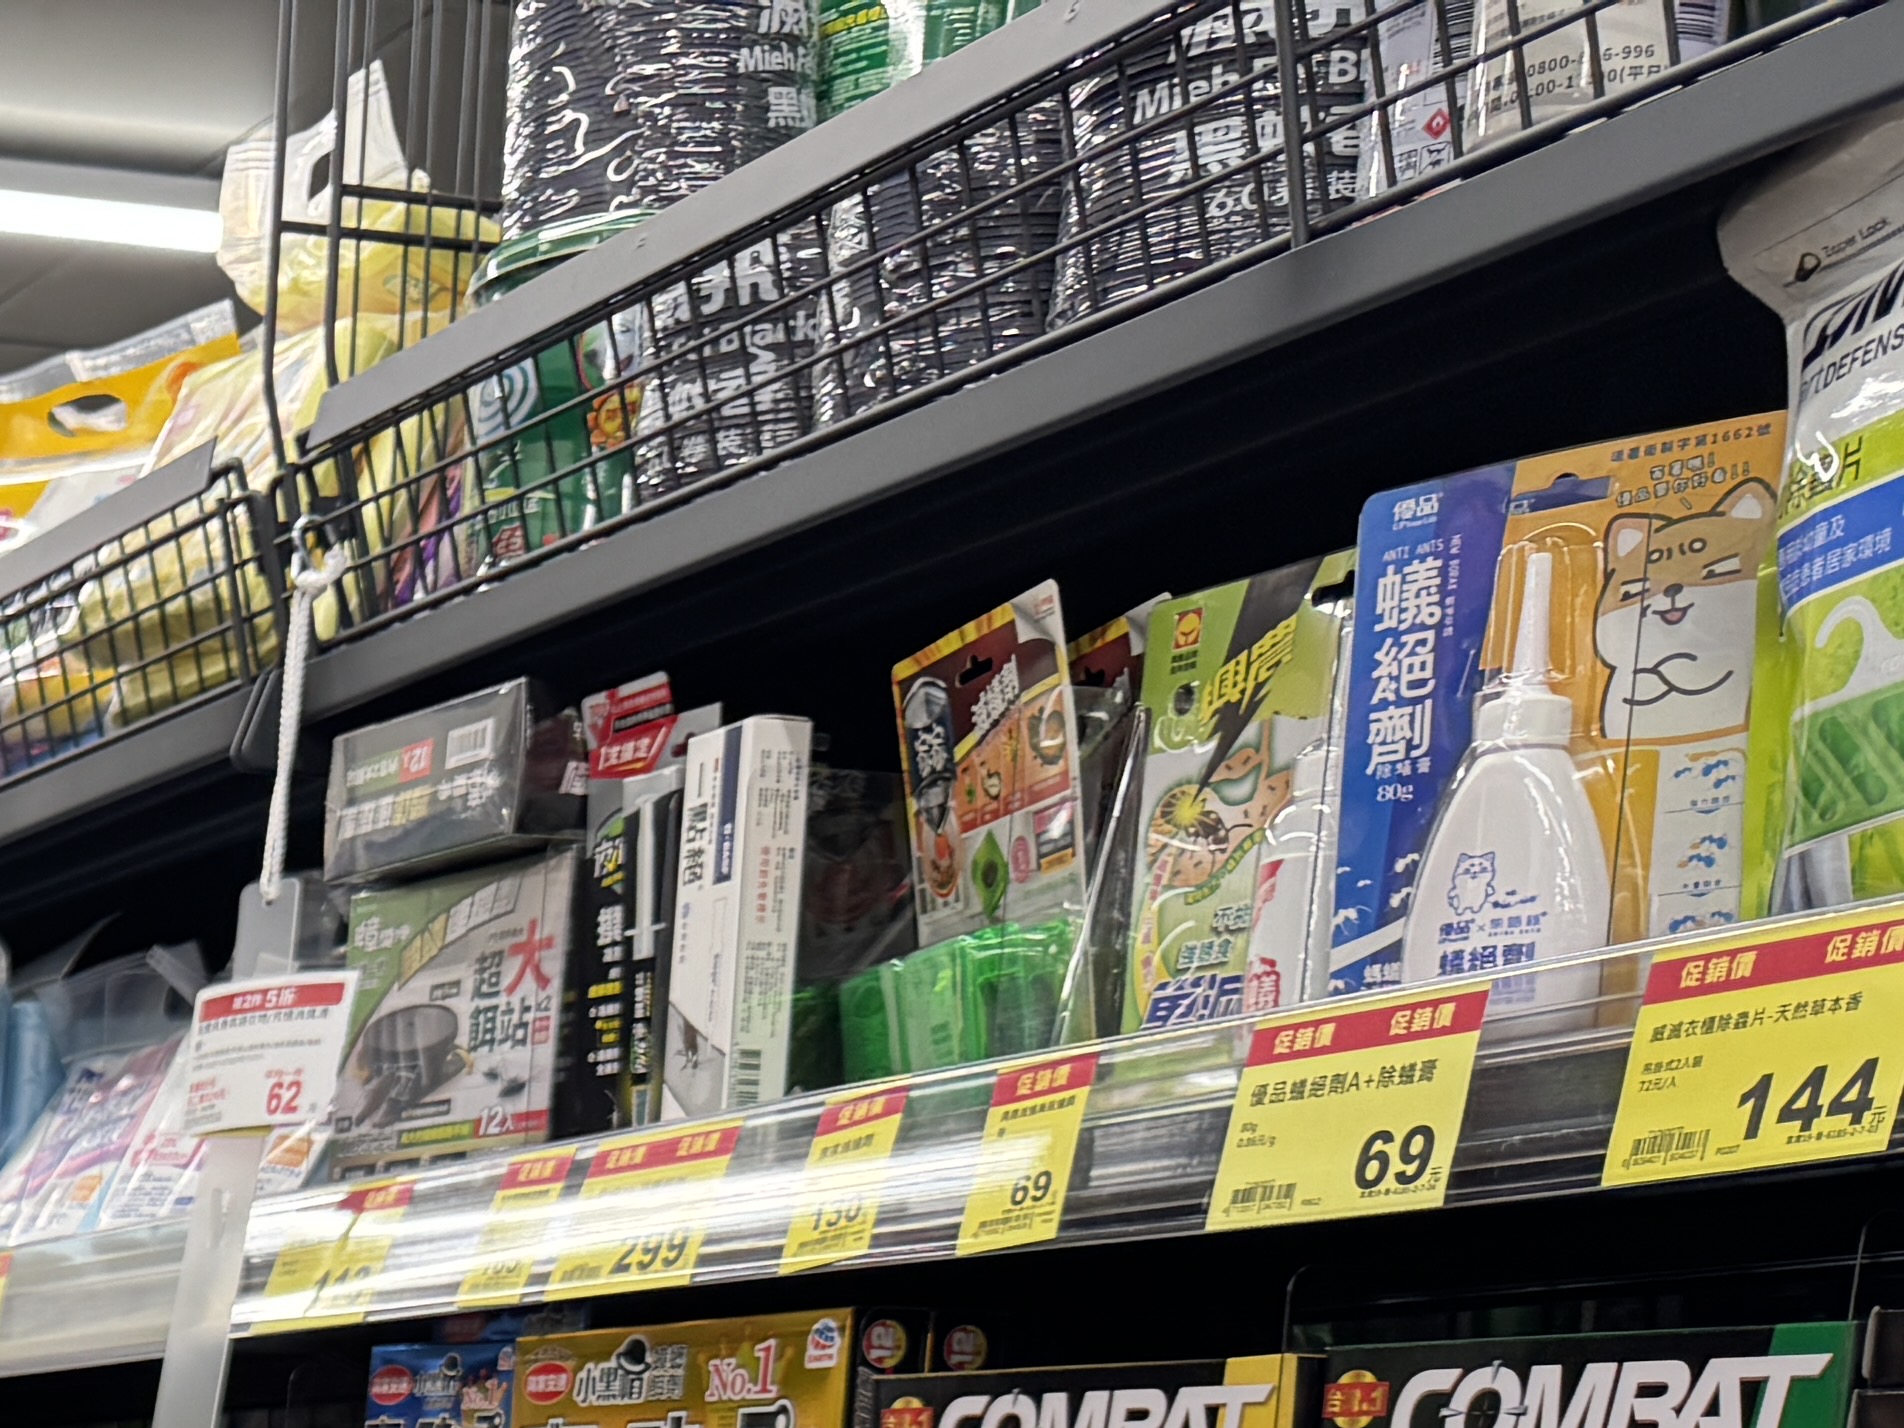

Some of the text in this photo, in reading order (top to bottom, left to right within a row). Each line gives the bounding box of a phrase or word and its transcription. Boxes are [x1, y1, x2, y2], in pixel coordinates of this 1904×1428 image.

[1366, 557, 1442, 776] 蟻絕劑
[1376, 782, 1414, 803] 80g
[266, 1079, 303, 1116] 62
[1737, 1056, 1880, 1141] 144
[1354, 1124, 1436, 1191] 69
[705, 1339, 779, 1402] No.1
